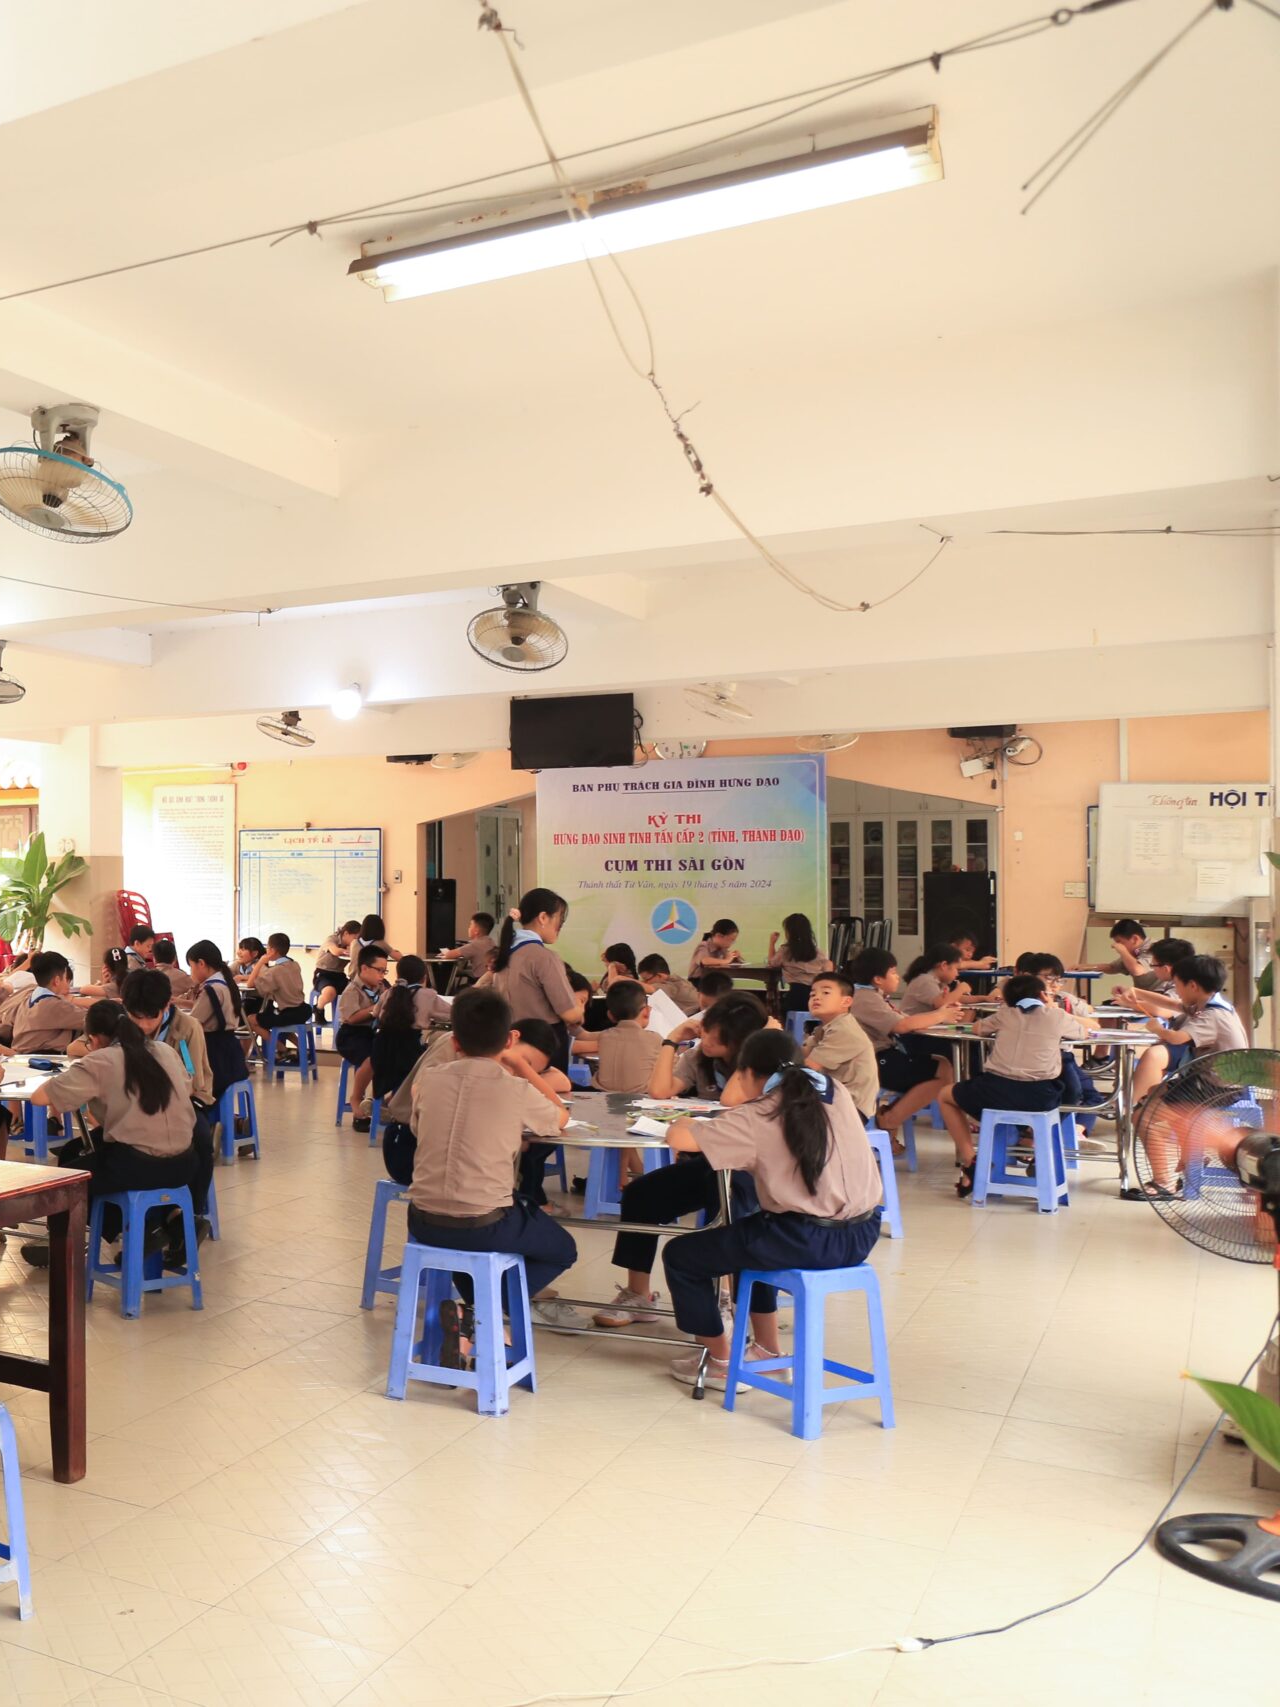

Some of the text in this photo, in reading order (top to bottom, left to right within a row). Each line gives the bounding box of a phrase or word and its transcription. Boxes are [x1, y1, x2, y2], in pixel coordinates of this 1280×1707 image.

[572, 783, 594, 793] BAN
[623, 779, 660, 791] TRÁCH
[663, 781, 683, 790] GIA
[687, 777, 715, 789] ĐÌNH
[720, 777, 751, 788] HƯNG
[1209, 789, 1247, 810] HỘI
[674, 814, 702, 825] THI
[603, 832, 626, 845] SINH
[676, 828, 695, 843] CẤP
[698, 831, 704, 843] 2
[604, 856, 745, 874] CỤM THI SÀI GÒN
[682, 880, 692, 888] 19
[721, 880, 727, 888] 5
[750, 880, 772, 888] 2024
